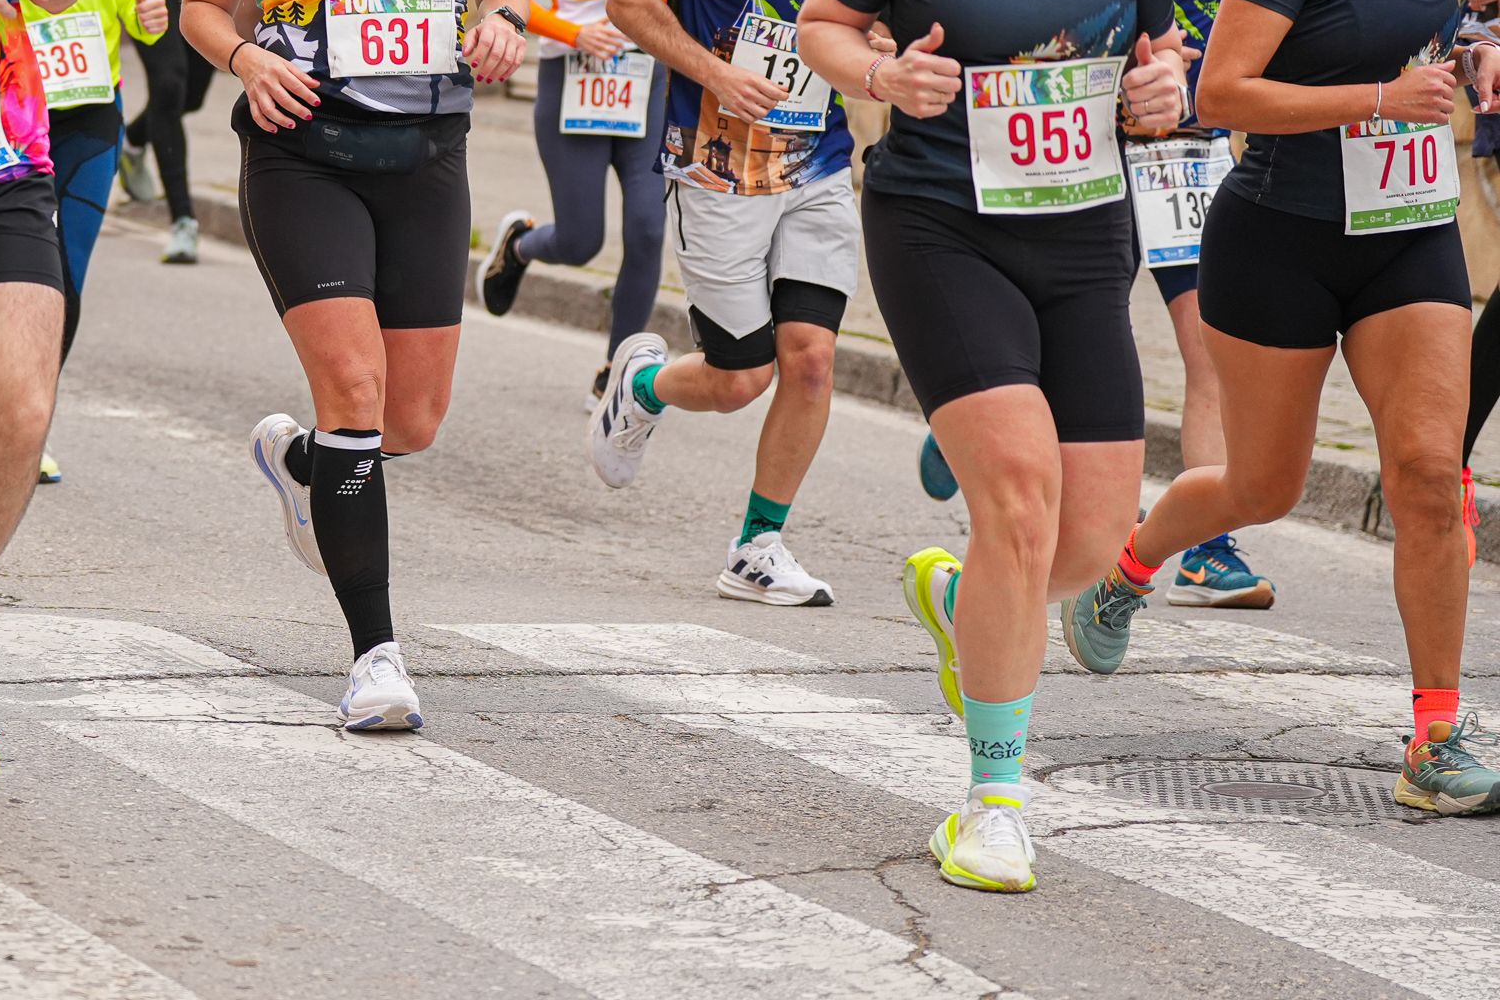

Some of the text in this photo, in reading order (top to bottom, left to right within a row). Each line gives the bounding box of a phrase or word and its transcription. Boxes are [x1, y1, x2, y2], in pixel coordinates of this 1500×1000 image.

[361, 18, 429, 66] 631
[756, 20, 797, 52] 21K
[34, 41, 88, 79] 636
[578, 78, 632, 109] 1084
[983, 71, 1036, 106] 10K
[1008, 106, 1092, 166] 953
[1150, 162, 1188, 189] 21K
[1374, 135, 1437, 189] 710
[317, 281, 345, 289] EVADICT
[970, 737, 1016, 750] STAY
[970, 747, 1021, 760] MAGIC
